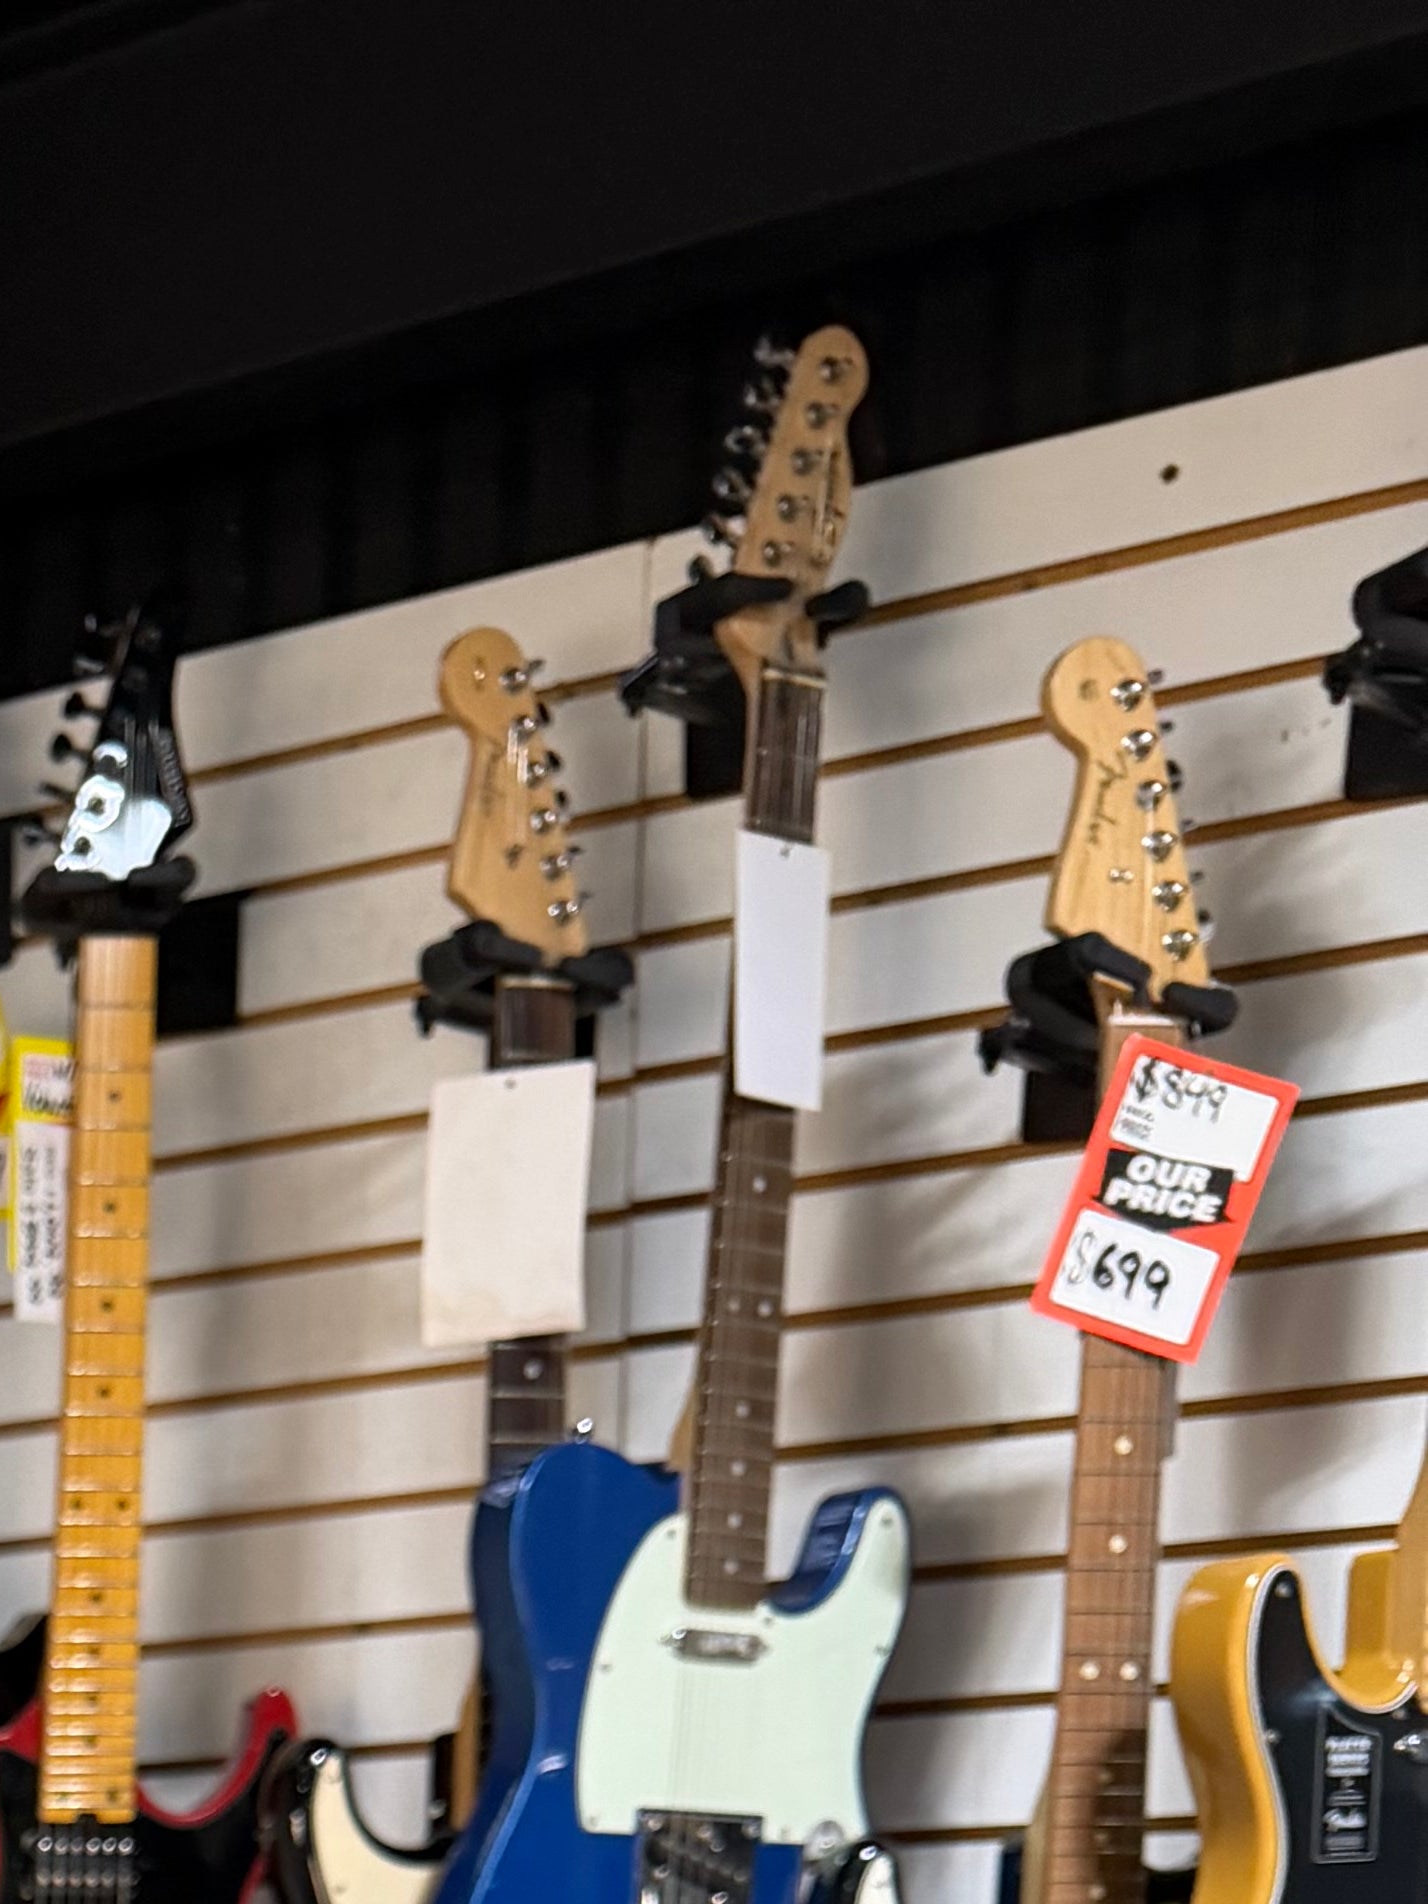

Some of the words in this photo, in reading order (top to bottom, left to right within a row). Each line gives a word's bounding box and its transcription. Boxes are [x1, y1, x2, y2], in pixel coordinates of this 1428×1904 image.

[1126, 1154, 1212, 1194] OUR
[1103, 1178, 1224, 1223] PRICE
[1064, 1228, 1171, 1310] $699
